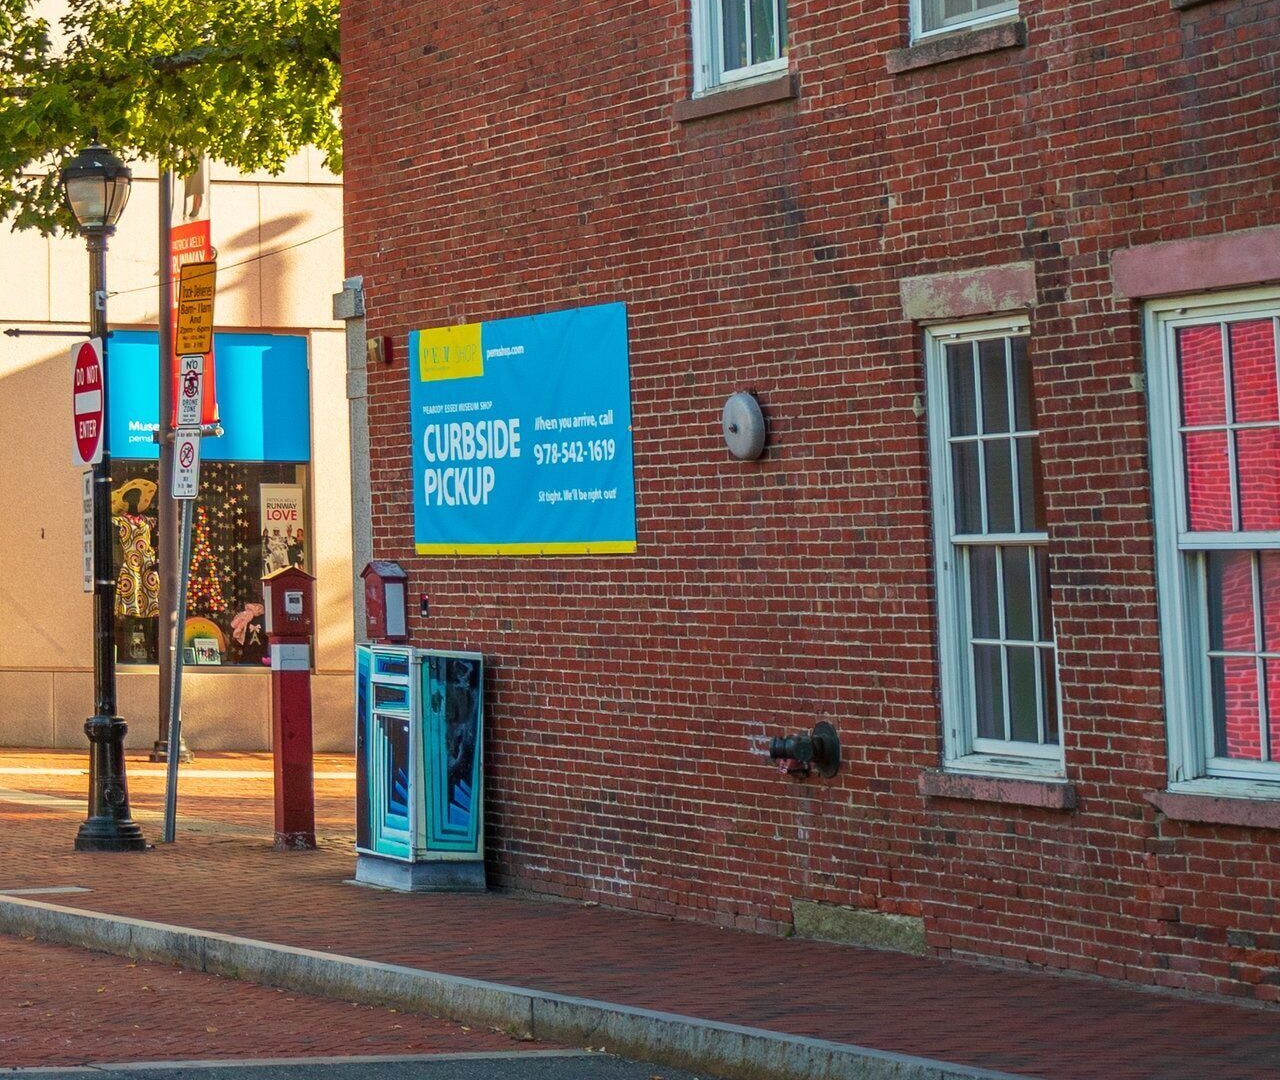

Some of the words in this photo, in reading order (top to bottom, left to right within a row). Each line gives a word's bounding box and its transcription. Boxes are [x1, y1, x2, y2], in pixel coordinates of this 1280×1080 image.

[76, 367, 85, 387] DO
[86, 364, 99, 385] NOT
[186, 360, 198, 370] NO
[79, 419, 97, 439] ENTER
[128, 420, 160, 432] Muse
[534, 415, 558, 431] When
[558, 416, 572, 433] you
[572, 411, 598, 428] arrive,
[598, 409, 614, 426] call
[423, 418, 521, 463] CURBSIDE
[533, 438, 616, 466] 978-542-1619
[424, 465, 495, 507] PICKUP
[266, 502, 298, 510] RUNWAY
[266, 509, 298, 521] LOVE
